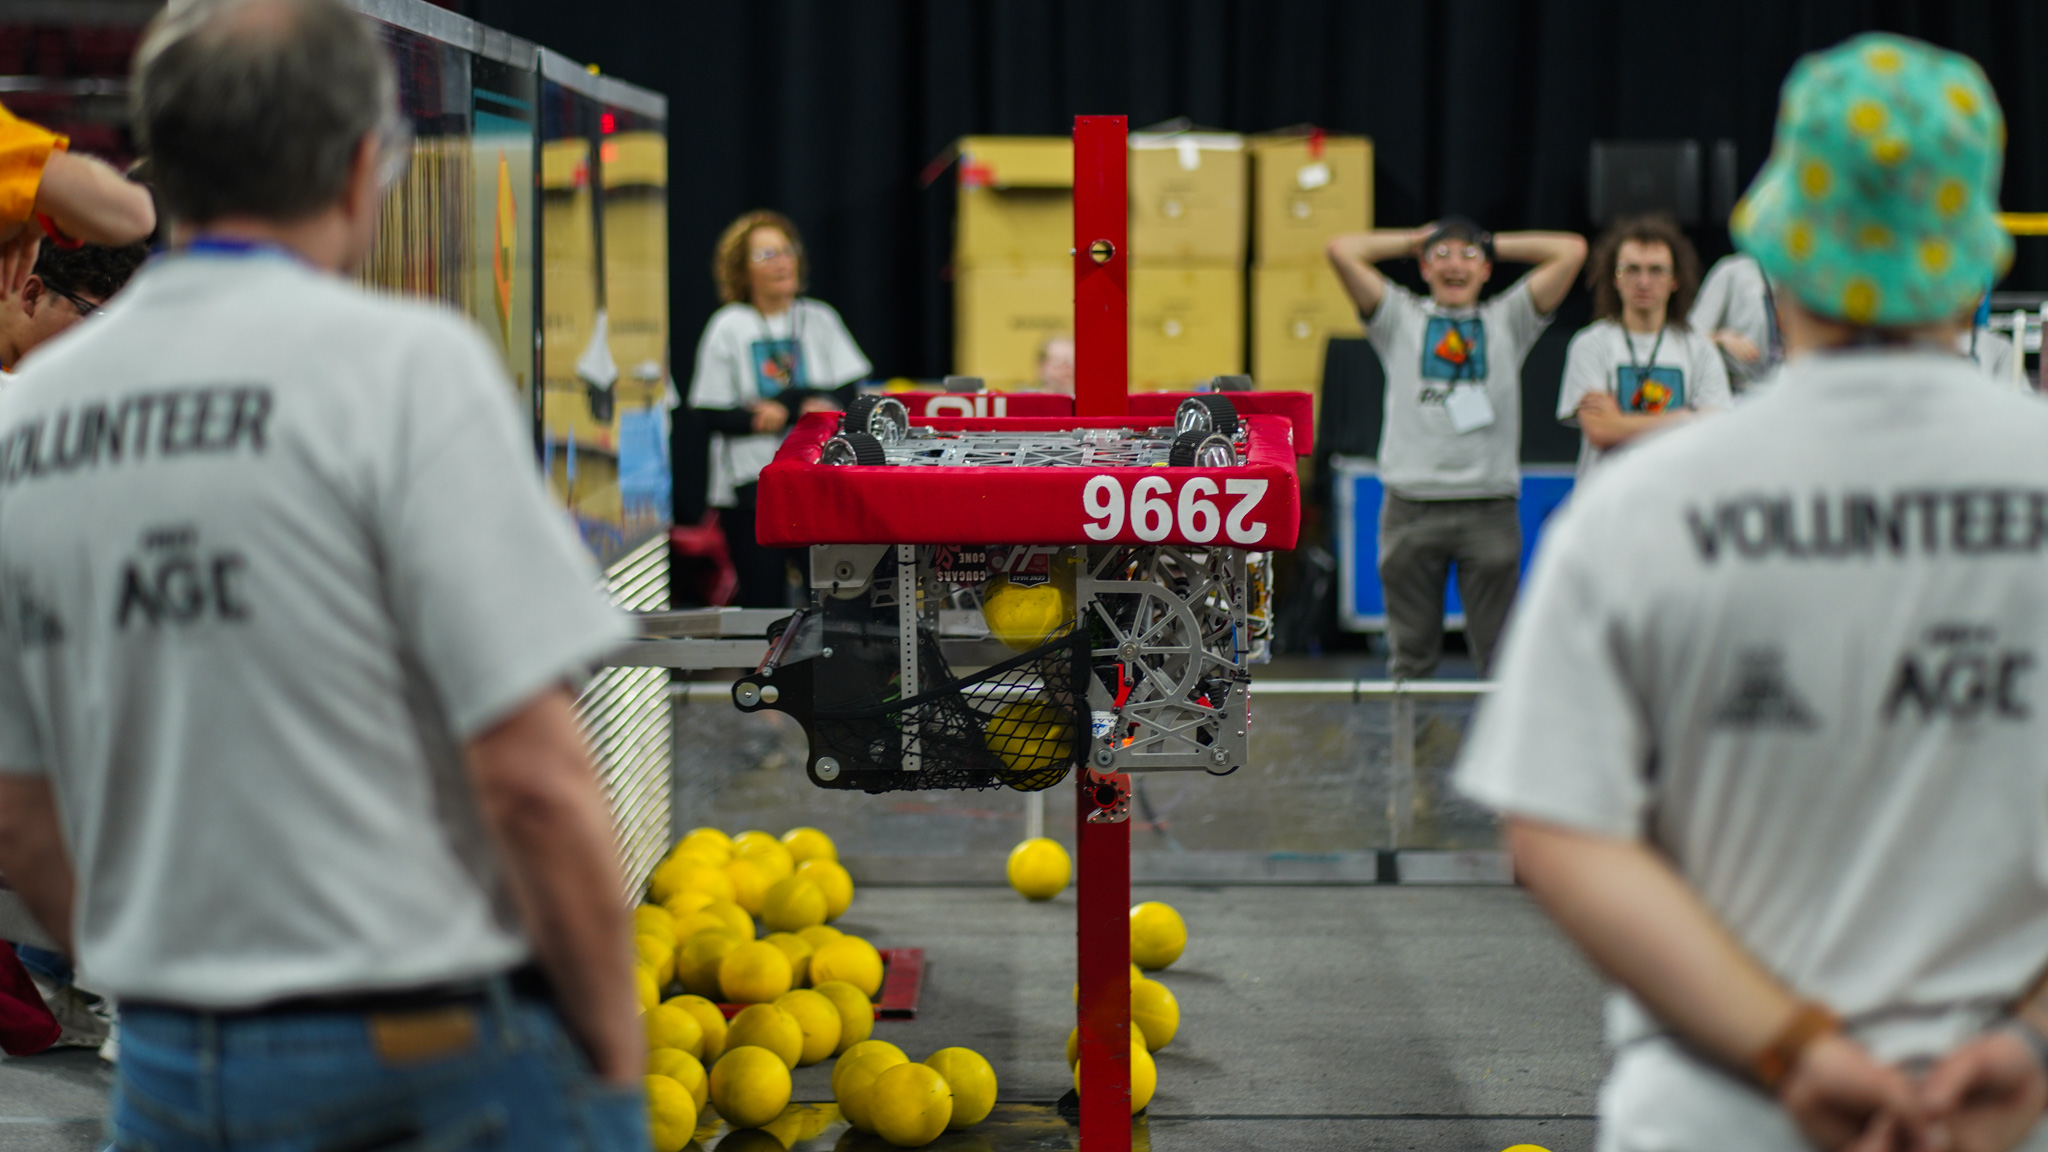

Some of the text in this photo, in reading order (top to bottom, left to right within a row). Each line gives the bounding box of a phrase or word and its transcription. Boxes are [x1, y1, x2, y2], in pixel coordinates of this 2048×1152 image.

[0, 385, 273, 482] OLUNTEER
[1083, 475, 1268, 544] 2996
[937, 570, 986, 582] COUGARS
